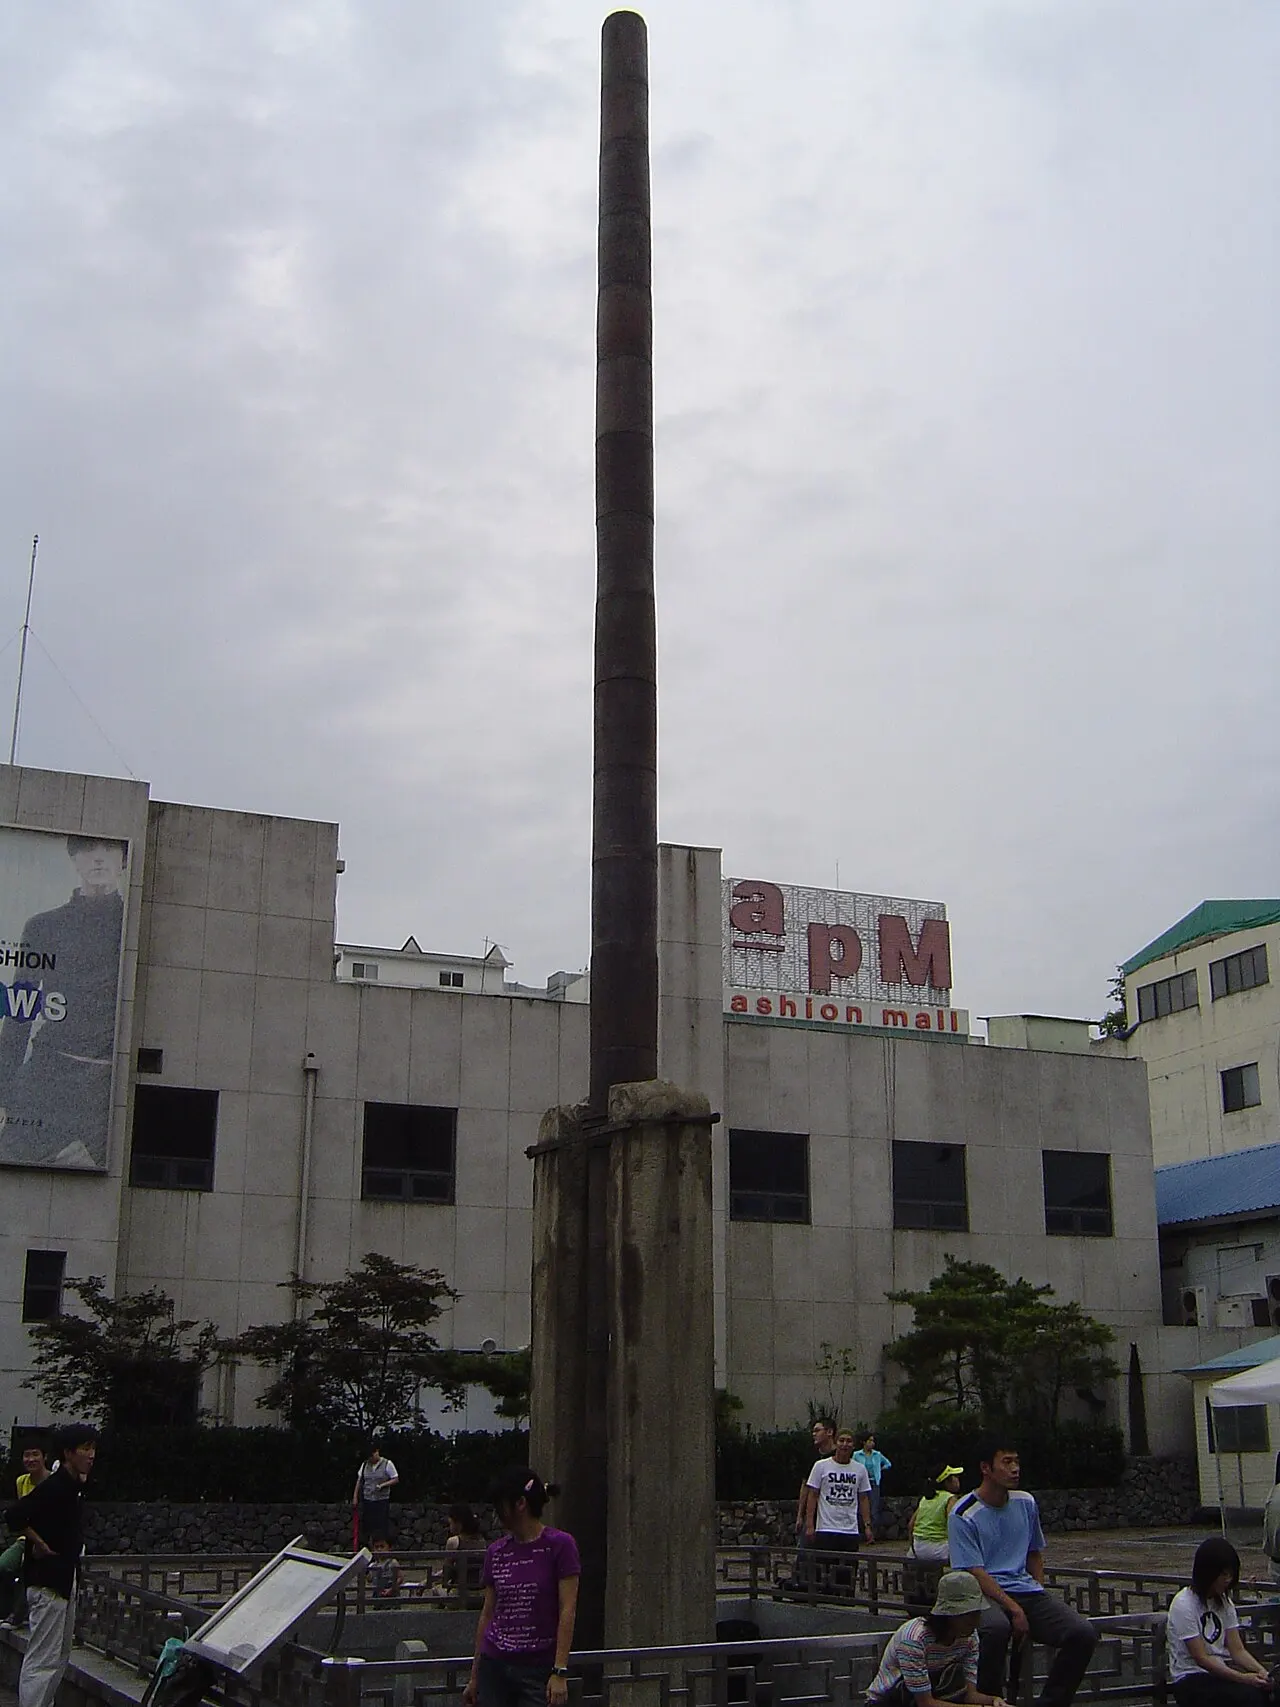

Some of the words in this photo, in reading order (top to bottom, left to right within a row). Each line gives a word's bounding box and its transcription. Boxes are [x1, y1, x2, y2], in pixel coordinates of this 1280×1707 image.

[731, 994, 862, 1023] ashion
[882, 1007, 958, 1032] mall
[828, 1472, 856, 1484] SLANG
